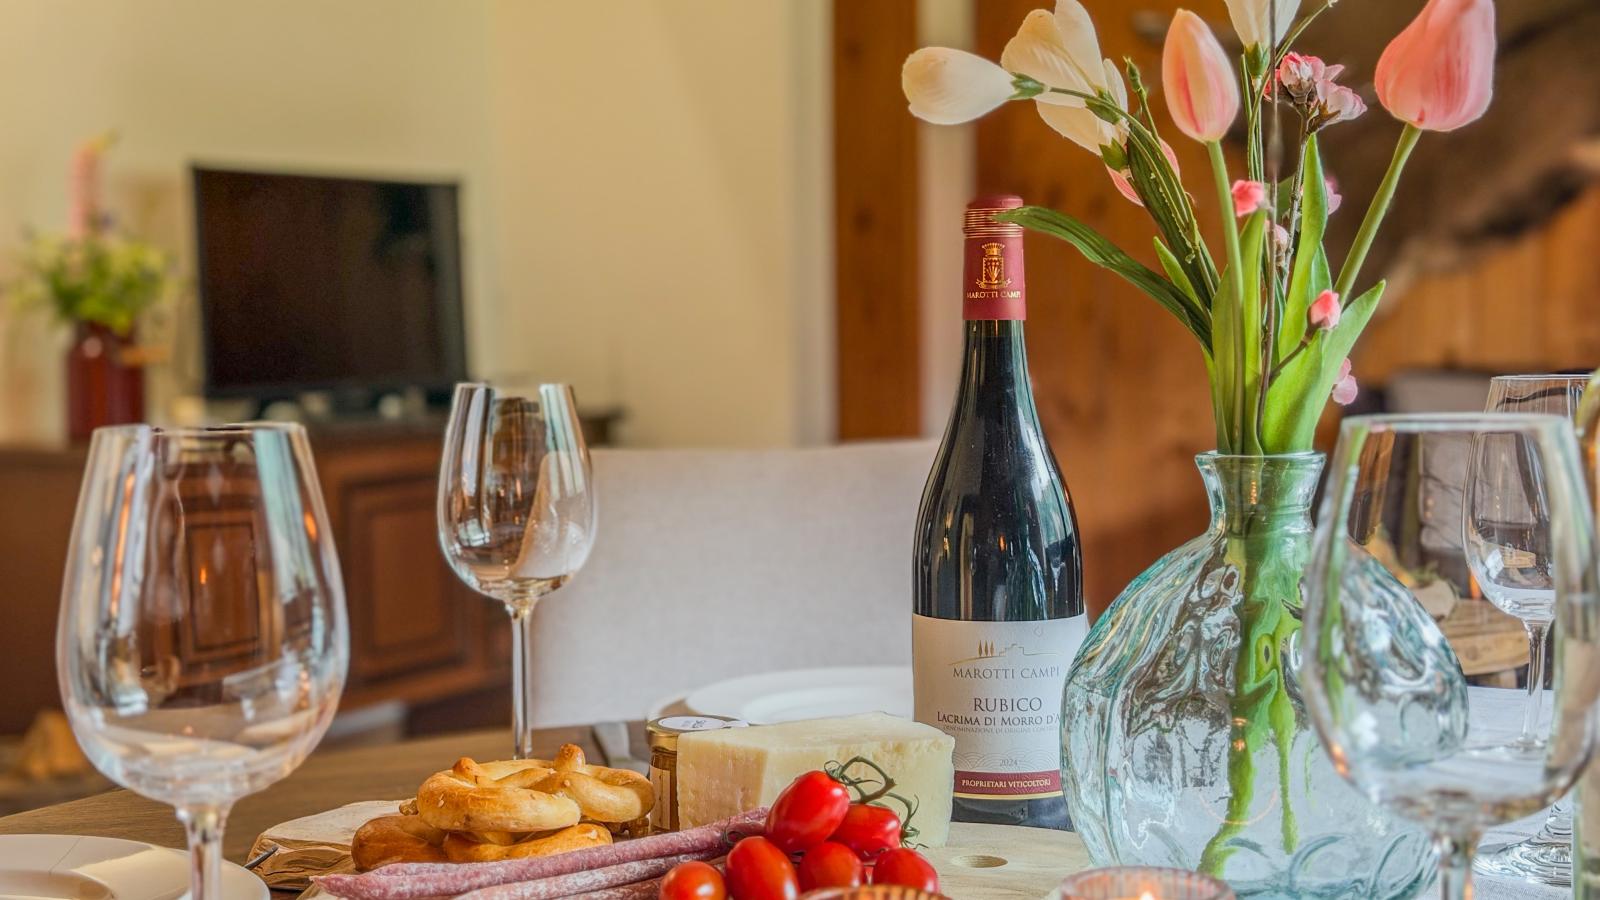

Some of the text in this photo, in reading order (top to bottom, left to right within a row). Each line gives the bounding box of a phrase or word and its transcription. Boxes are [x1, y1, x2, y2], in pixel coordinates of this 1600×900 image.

[952, 666, 1059, 679] MAROTTI CAMPI
[973, 697, 1042, 712] RUBICO
[984, 717, 996, 726] DI
[961, 778, 1051, 788] PROPRIETARI VITICOLTORI
